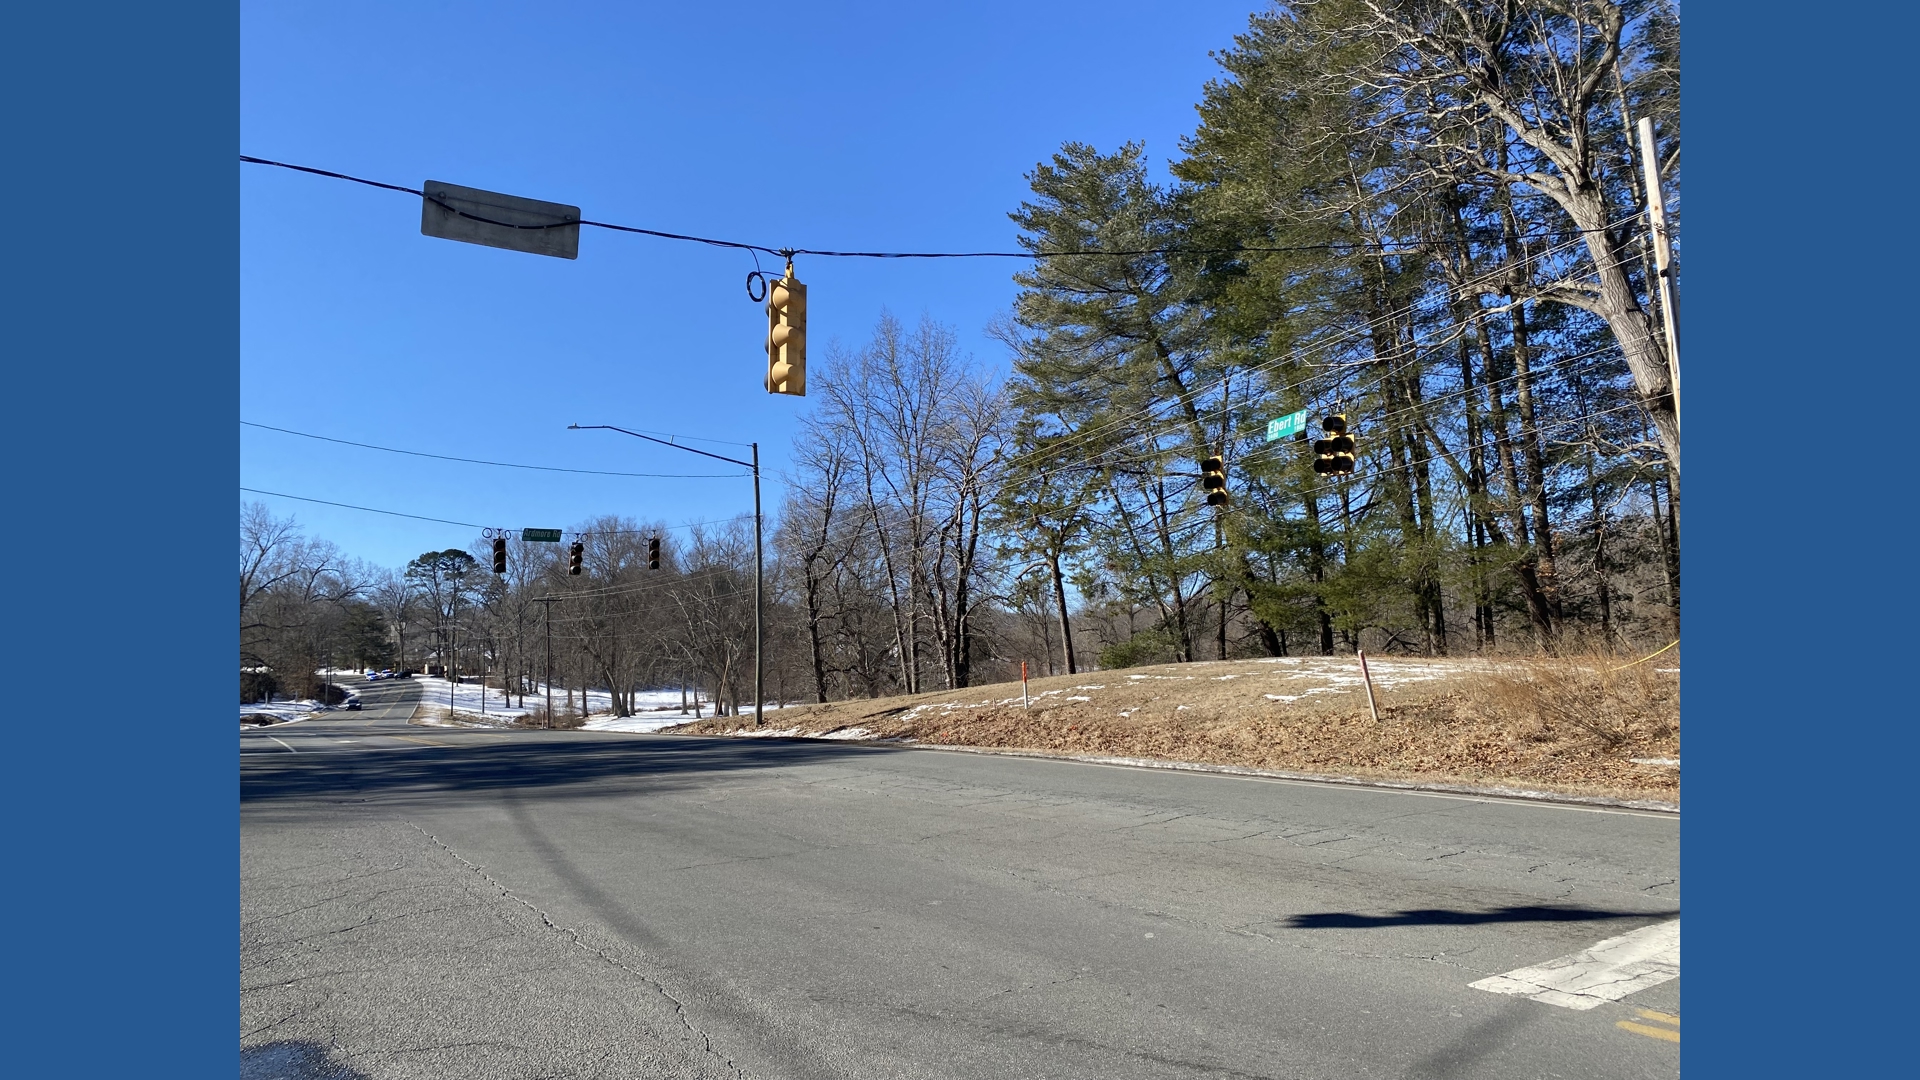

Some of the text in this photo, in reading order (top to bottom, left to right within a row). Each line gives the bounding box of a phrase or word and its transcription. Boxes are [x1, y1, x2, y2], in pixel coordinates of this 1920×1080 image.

[1268, 410, 1306, 434] Ebert Rd
[524, 529, 561, 538] Ardmore Rd
